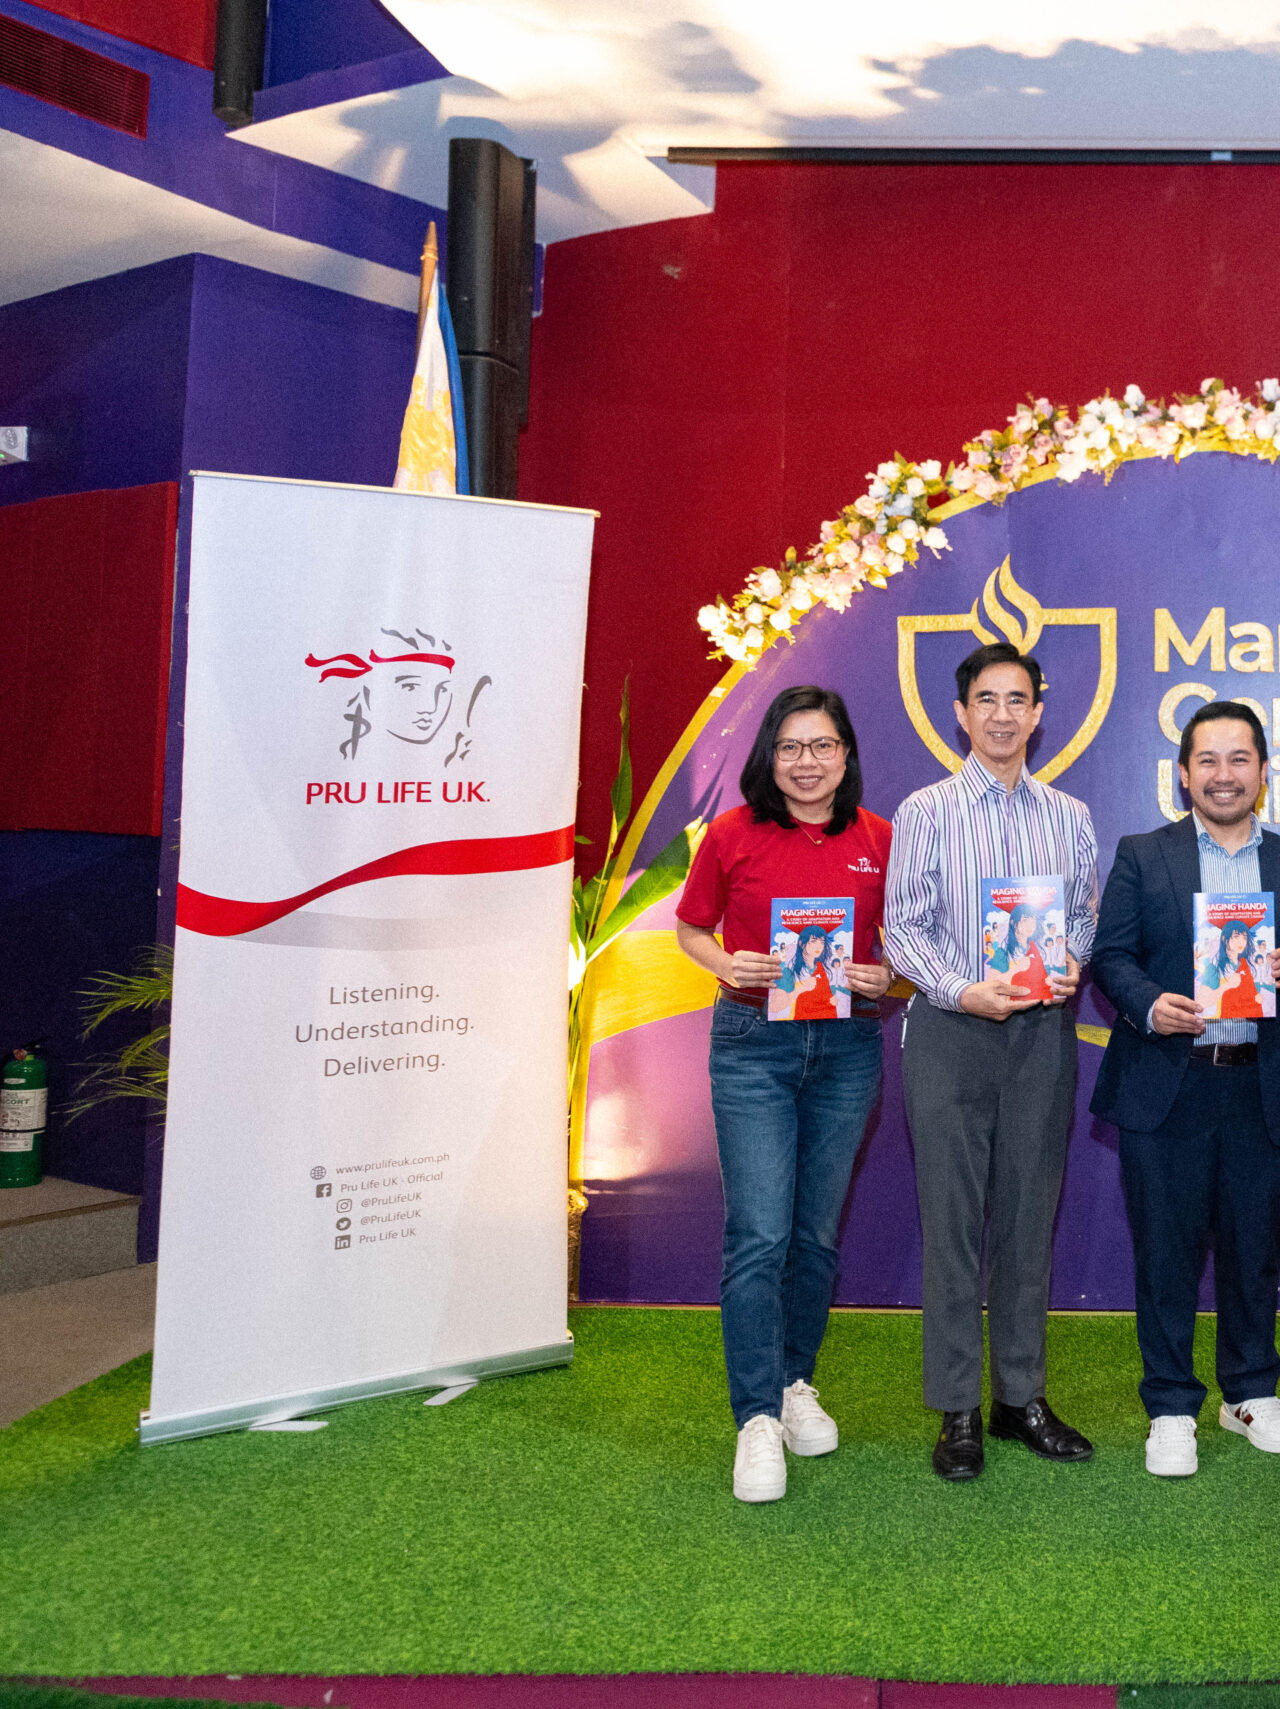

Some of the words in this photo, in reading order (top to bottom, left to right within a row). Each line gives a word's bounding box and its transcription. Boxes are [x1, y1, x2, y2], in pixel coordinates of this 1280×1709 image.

[306, 781, 366, 804] PRU
[377, 781, 432, 803] LIFE
[442, 781, 490, 803] U.K.
[780, 908, 815, 917] MAGING
[816, 908, 847, 916] HANDA
[1237, 902, 1268, 910] HANDA
[330, 983, 440, 1005] Listening.
[295, 1014, 475, 1043] Understanding.
[323, 1052, 446, 1077] Delivering.
[335, 1152, 450, 1174] www.prulifeuk.com.ph
[340, 1183, 358, 1193] Pru
[361, 1179, 380, 1190] Life
[382, 1176, 399, 1187] UK
[407, 1171, 443, 1184] Official
[360, 1191, 422, 1208] @PruLifeUK
[360, 1208, 421, 1225] @PruLifeUK
[359, 1234, 376, 1244] Pru
[379, 1231, 398, 1241] Life
[401, 1227, 416, 1238] UK
